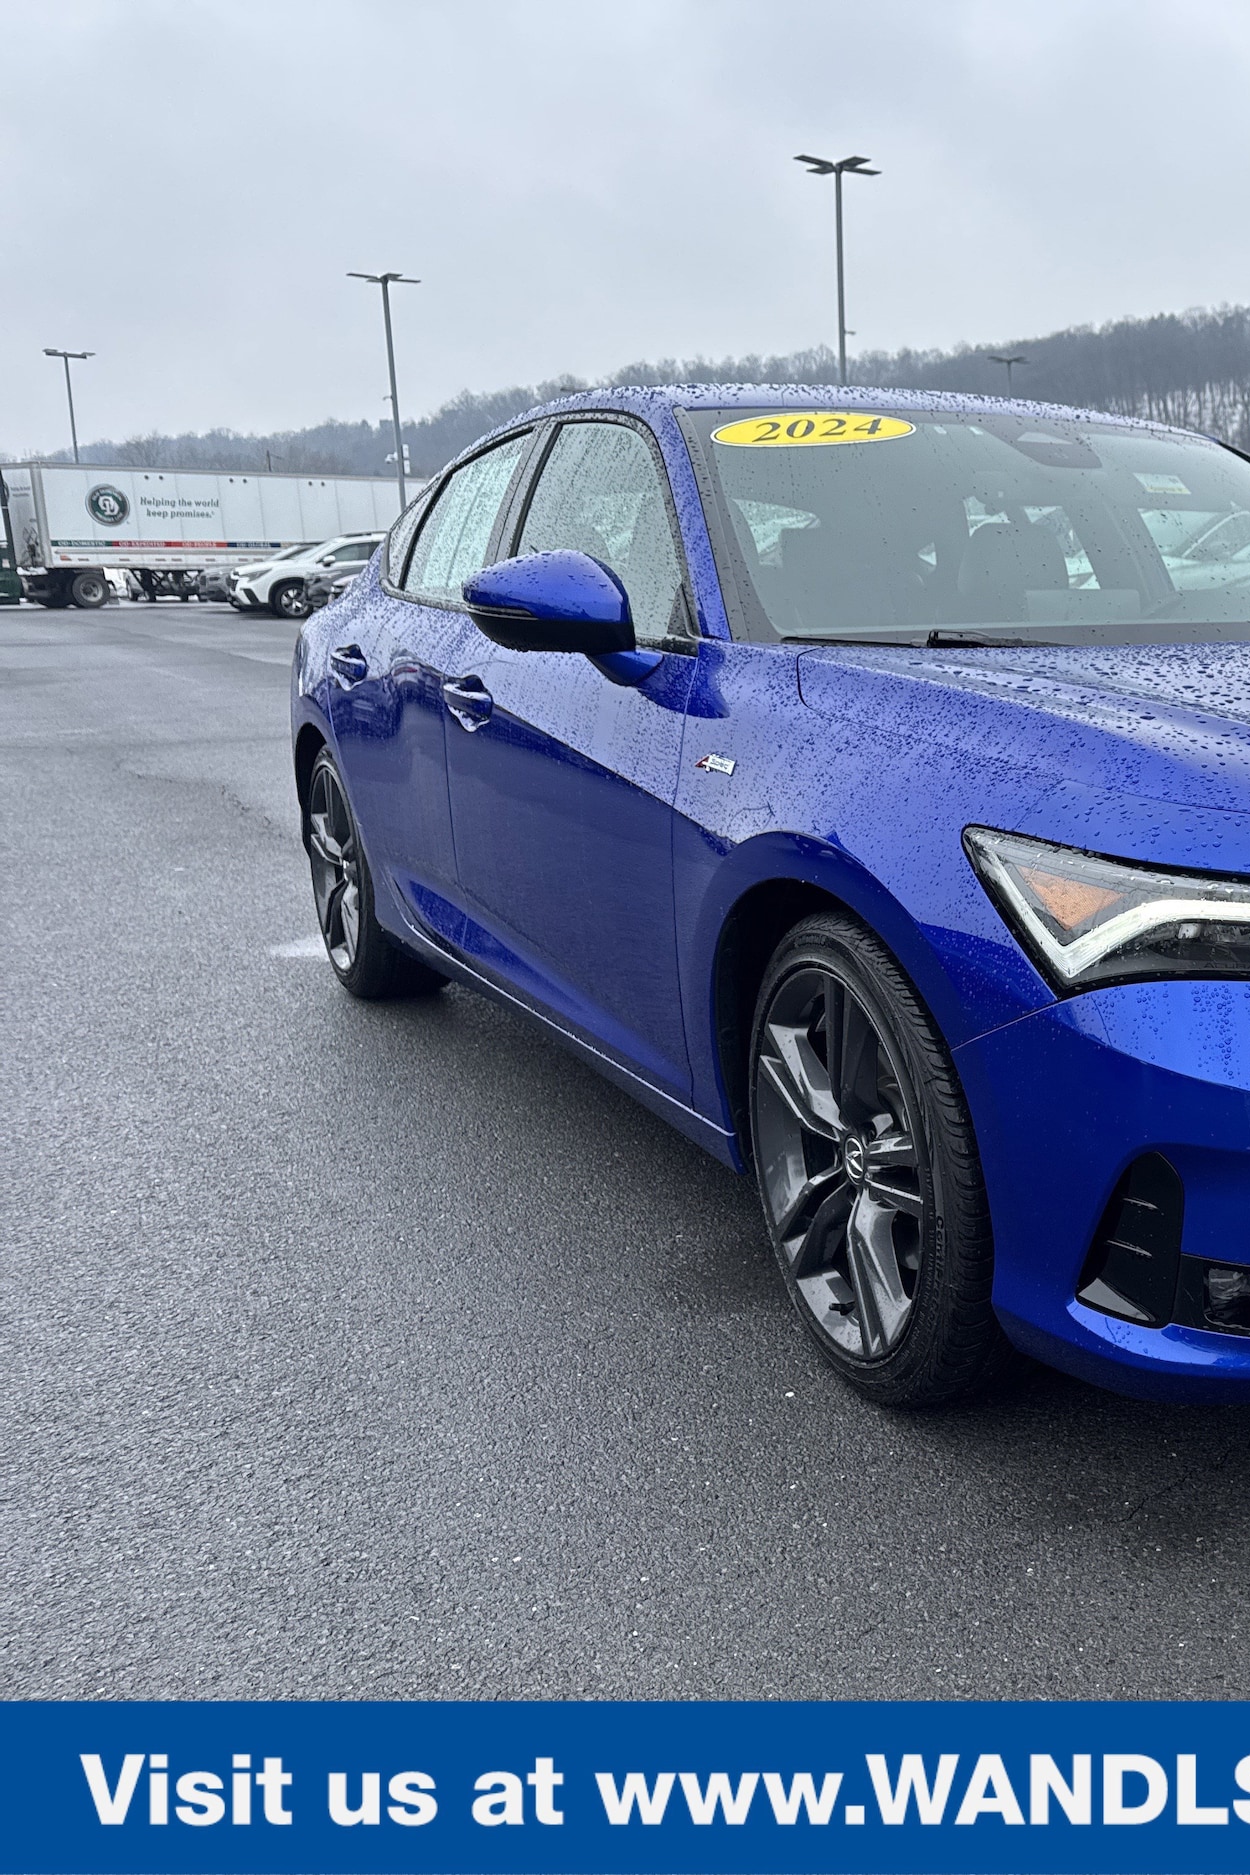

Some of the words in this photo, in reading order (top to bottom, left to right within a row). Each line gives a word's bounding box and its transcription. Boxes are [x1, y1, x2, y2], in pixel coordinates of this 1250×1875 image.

[751, 417, 883, 443] 2024
[140, 496, 176, 508] Helping
[178, 497, 192, 507] the
[194, 498, 219, 507] world
[147, 508, 168, 519] keep
